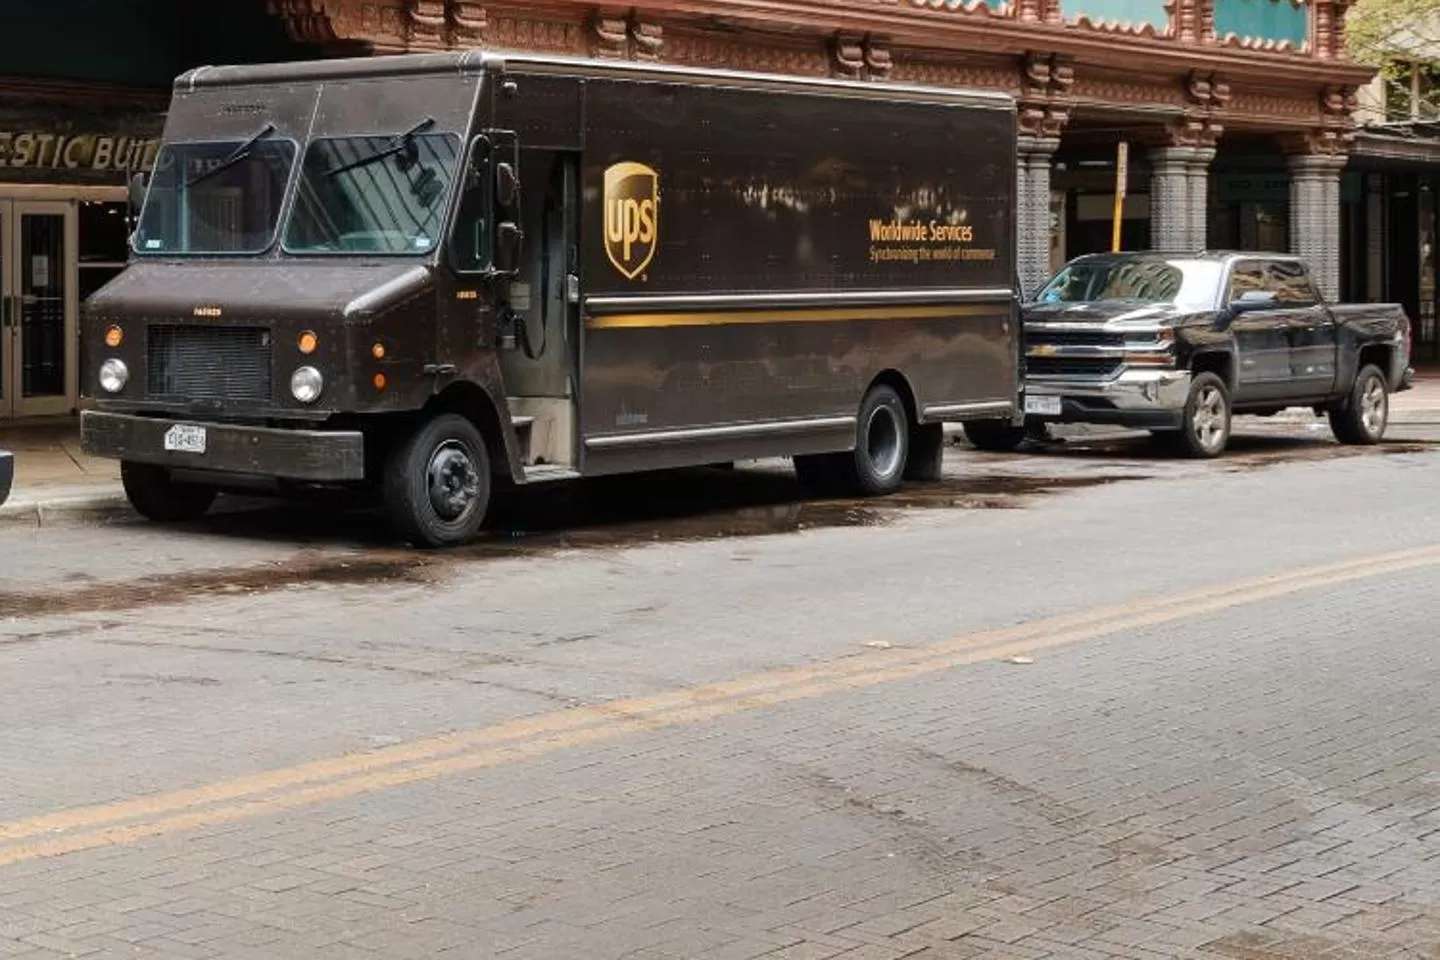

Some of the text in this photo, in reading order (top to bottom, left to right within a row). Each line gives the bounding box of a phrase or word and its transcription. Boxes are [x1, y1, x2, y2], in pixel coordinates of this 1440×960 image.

[608, 199, 654, 261] ups
[869, 219, 973, 242] Worldwide Services
